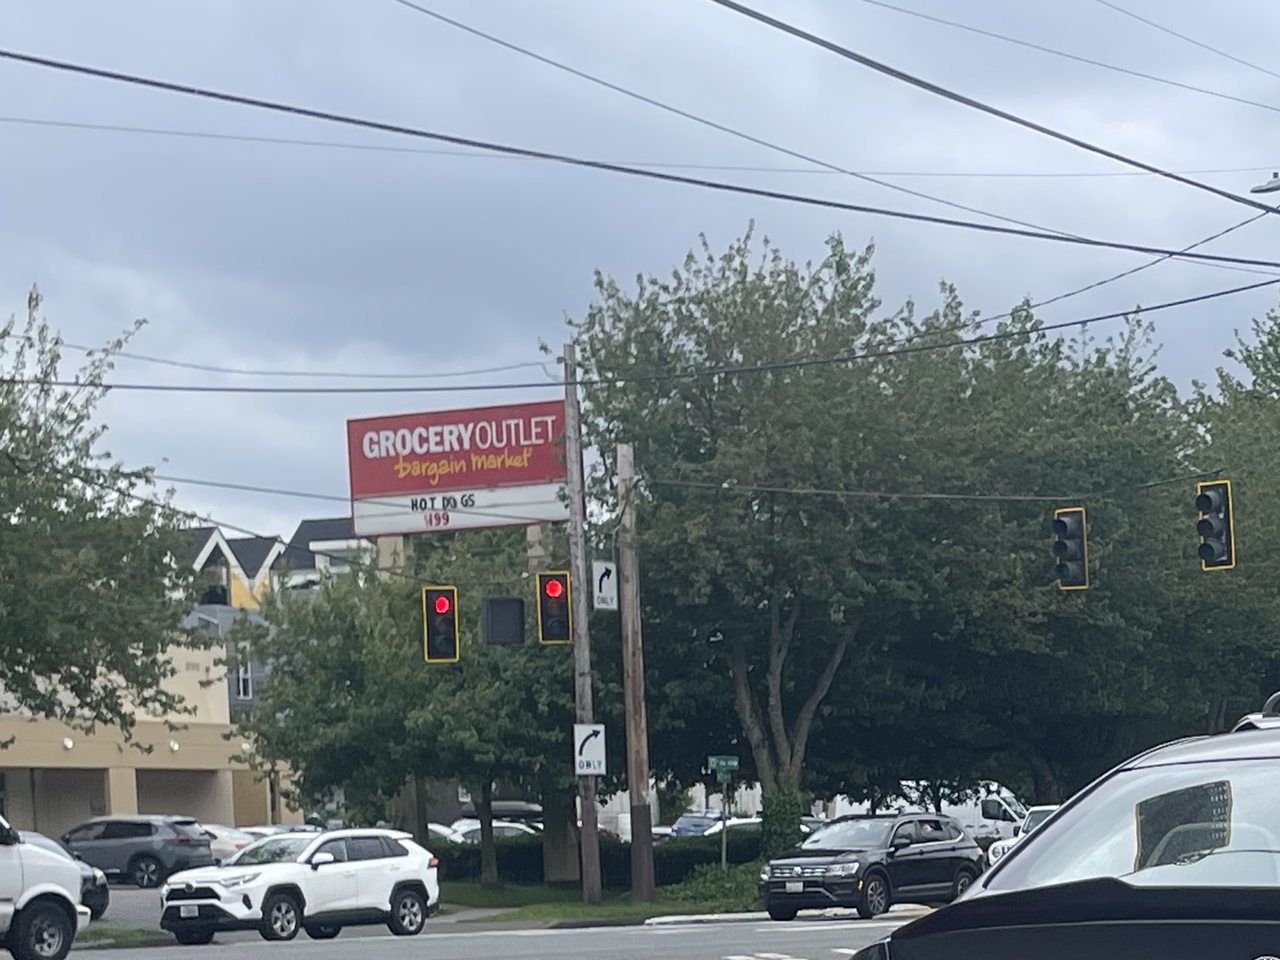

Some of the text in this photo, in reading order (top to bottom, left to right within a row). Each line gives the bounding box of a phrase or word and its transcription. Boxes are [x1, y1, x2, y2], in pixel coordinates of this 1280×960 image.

[394, 447, 533, 486] bargain market
[411, 496, 437, 511] HOT
[578, 760, 602, 770] ONLY
